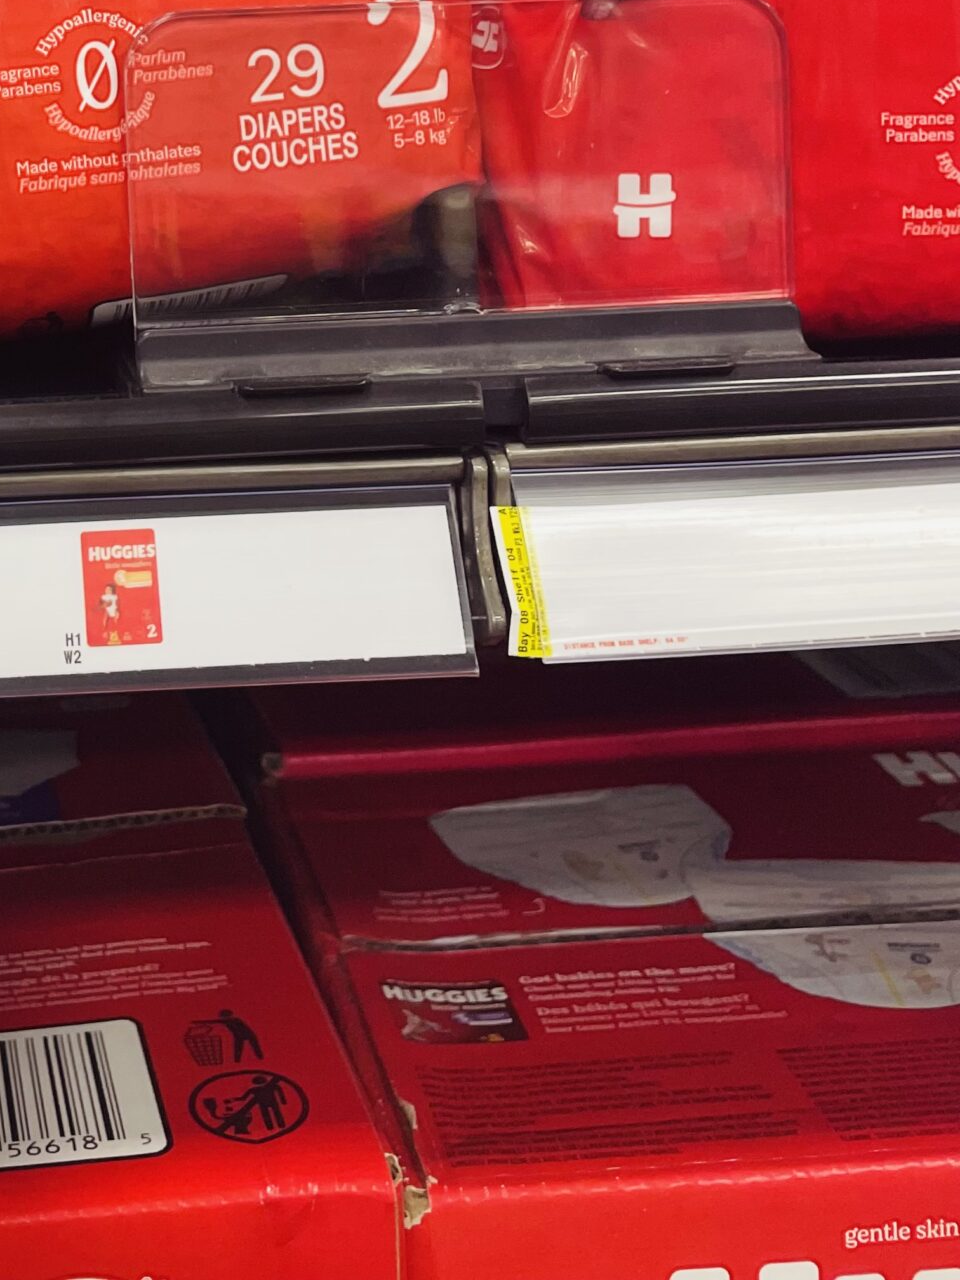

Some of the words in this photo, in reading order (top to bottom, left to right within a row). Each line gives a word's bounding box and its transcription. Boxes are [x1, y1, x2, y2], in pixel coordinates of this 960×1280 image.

[35, 8, 149, 56] Hypoallergenic
[133, 65, 214, 85] Parabènes
[247, 42, 325, 104] 29
[239, 102, 346, 142] DIAPERS
[881, 111, 955, 129] Fragrance
[429, 129, 447, 146] kg
[886, 128, 955, 143] Parabens
[232, 131, 359, 172] COUCHES
[16, 158, 58, 177] Made
[60, 153, 119, 172] without
[19, 174, 87, 193] Fabriqué
[91, 170, 125, 185] sans
[902, 204, 943, 219] Made
[88, 544, 157, 562] HUGGIES
[506, 547, 515, 561] 04
[511, 568, 526, 603] Shelf
[520, 610, 529, 624] 08
[65, 633, 82, 648] H1
[146, 623, 158, 639] 2
[518, 631, 528, 653] Bay
[64, 649, 82, 665] W2
[382, 983, 509, 1006] HUGGIES
[8, 1135, 99, 1158] 56618
[140, 1132, 153, 1145] 5
[844, 1221, 911, 1249] gentle
[916, 1218, 960, 1240] skin
